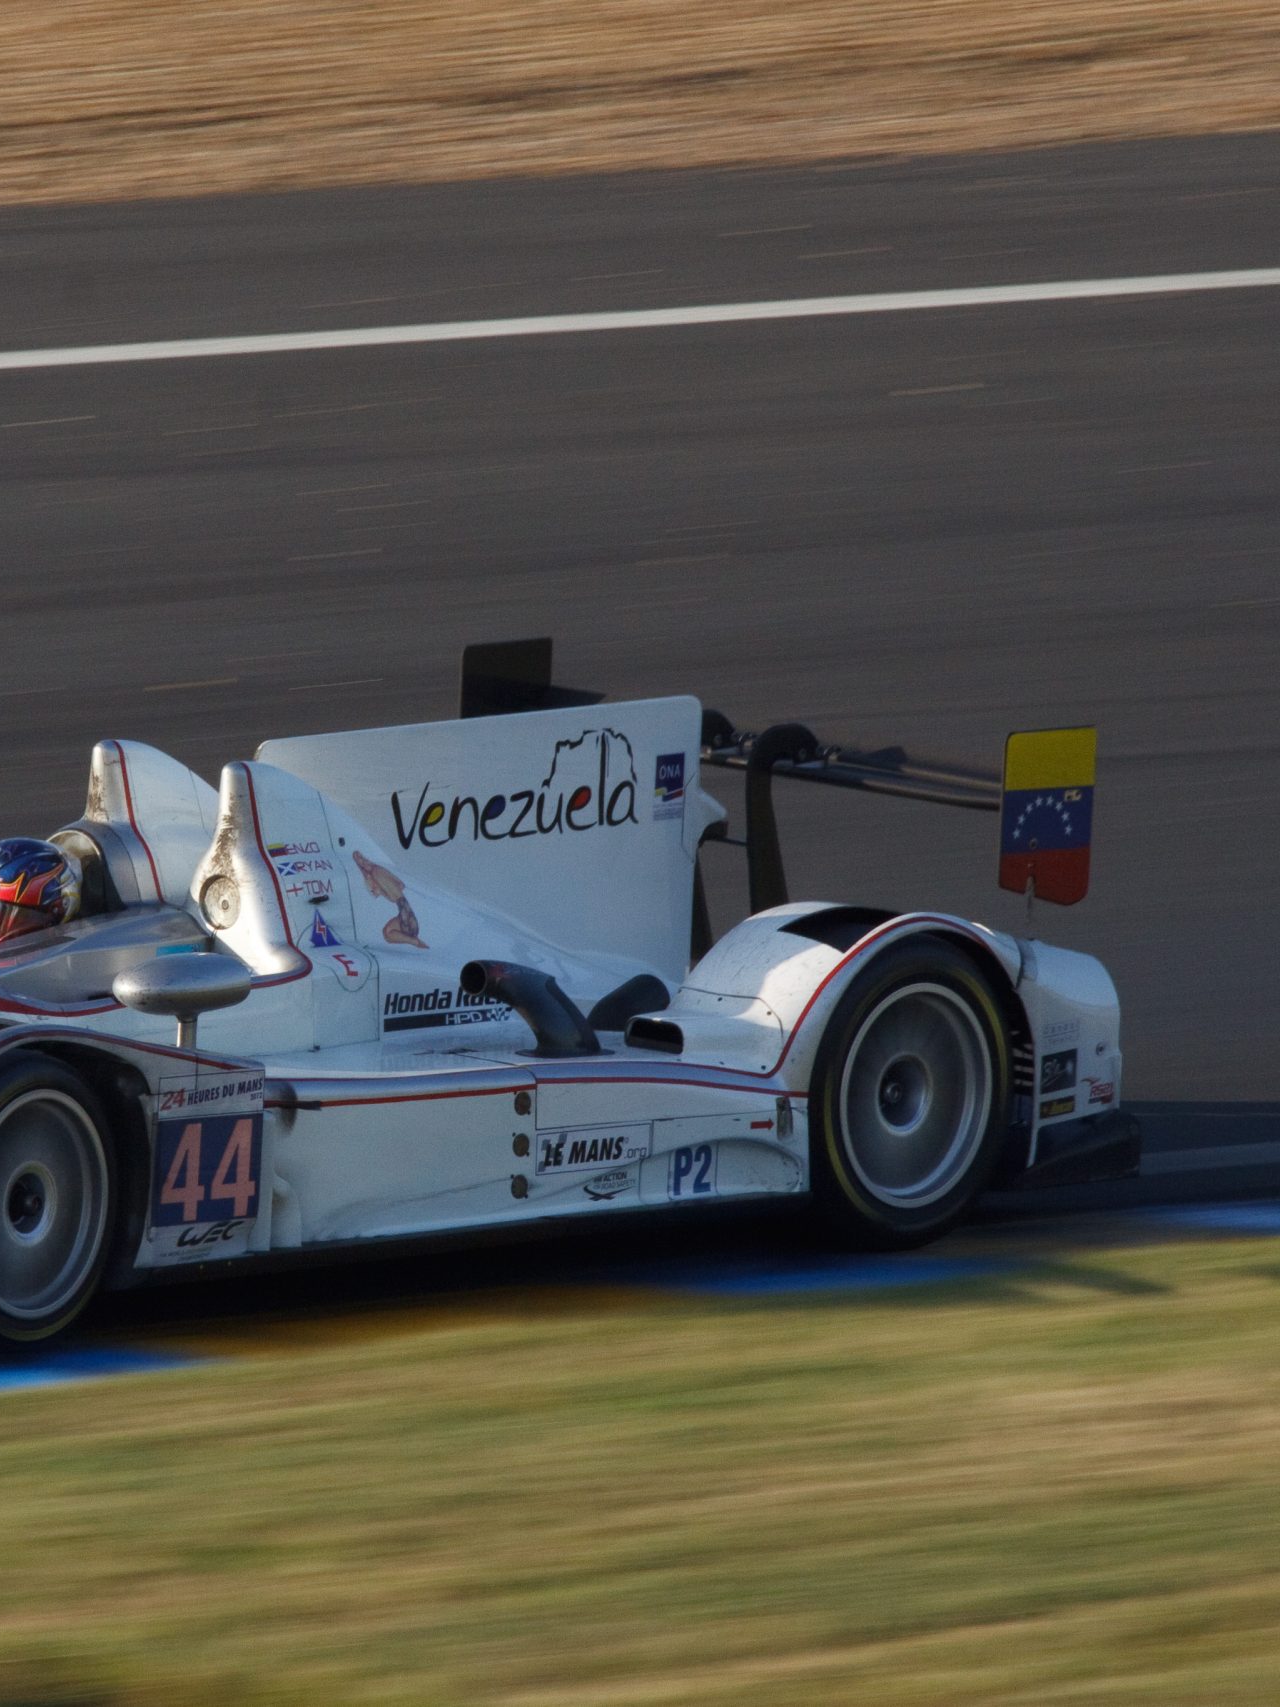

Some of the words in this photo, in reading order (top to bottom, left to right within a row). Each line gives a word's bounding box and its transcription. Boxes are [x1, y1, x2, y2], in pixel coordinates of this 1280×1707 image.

[659, 764, 681, 780] ONA
[391, 731, 639, 849] Venezuela
[295, 860, 333, 873] RYAN
[303, 880, 334, 896] TOM
[384, 988, 452, 1015] Honda
[446, 1011, 482, 1025] HPD
[161, 1088, 185, 1111] 24
[187, 1086, 220, 1105] HEURES
[222, 1083, 235, 1097] DU
[237, 1078, 262, 1095] MANS
[544, 1142, 565, 1166] LE
[568, 1136, 624, 1164] MANS
[160, 1119, 255, 1222] 44
[673, 1144, 712, 1196] P2
[177, 1220, 244, 1247] WEC
